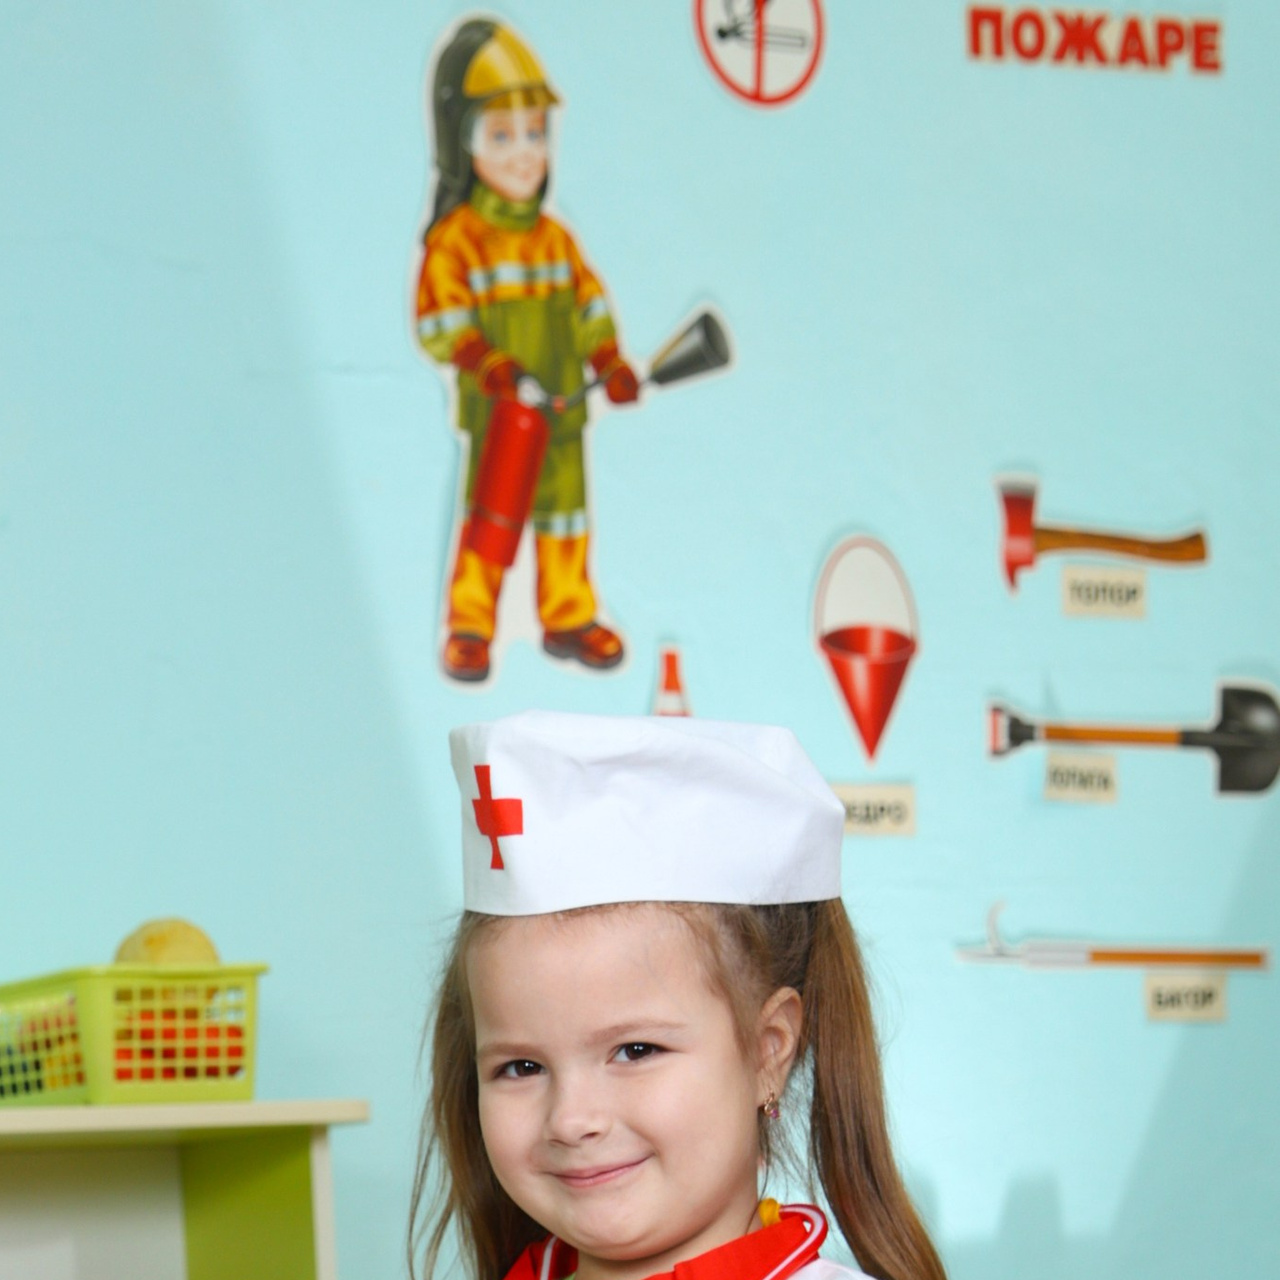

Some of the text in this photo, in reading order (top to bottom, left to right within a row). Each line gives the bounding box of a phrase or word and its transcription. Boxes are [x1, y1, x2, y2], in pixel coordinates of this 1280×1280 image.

[969, 7, 1221, 72] ПОЖАРЕ
[1069, 580, 1139, 607] ТОПОР
[845, 801, 907, 825] ЕДРО
[1154, 986, 1214, 1011] БАГОР
